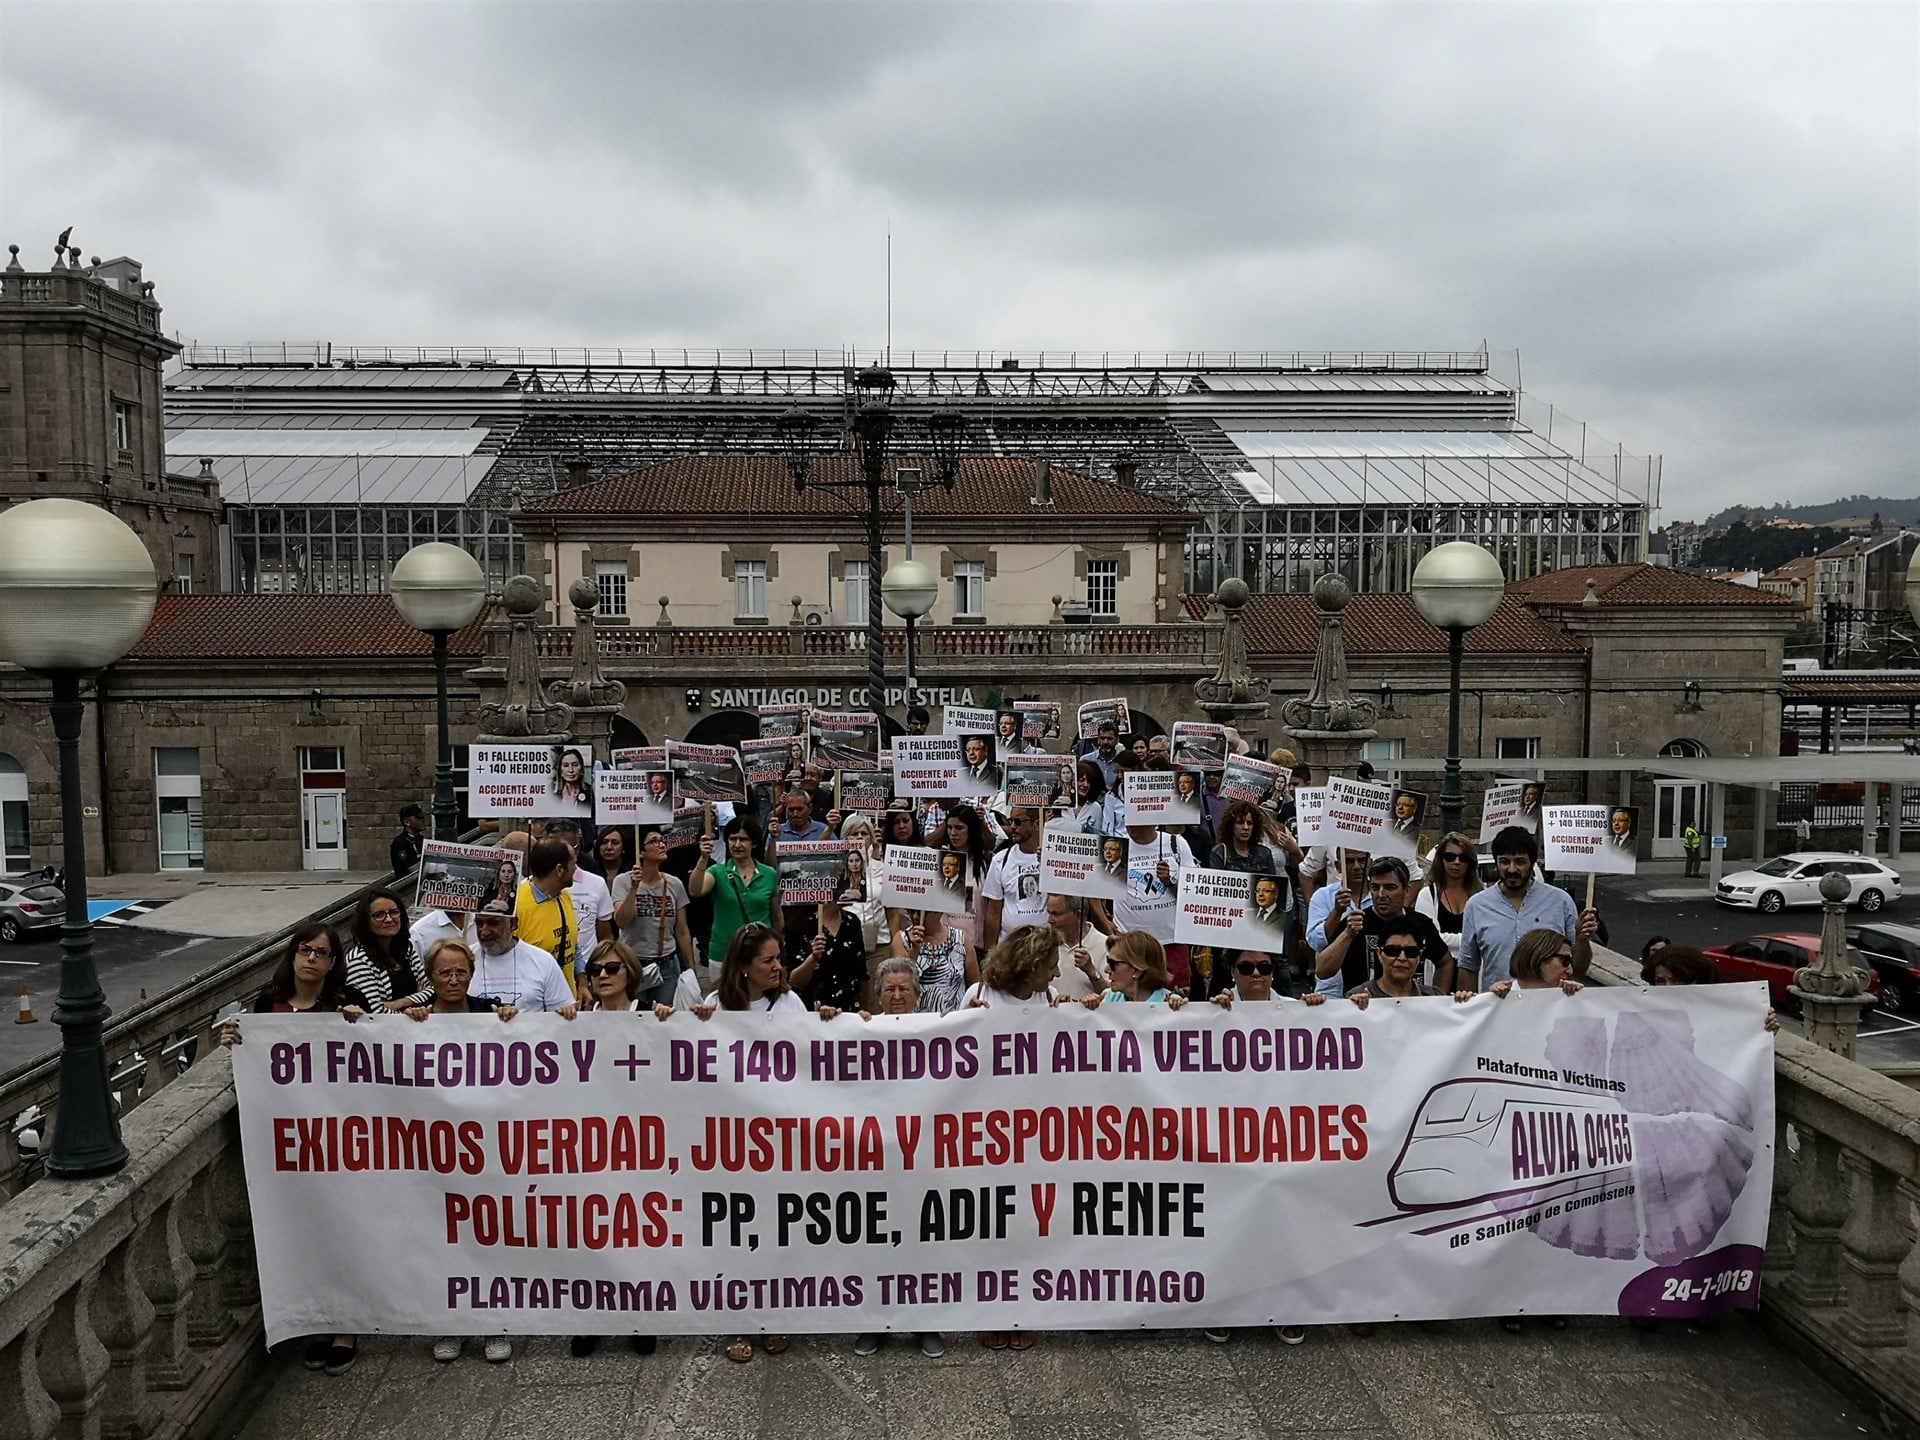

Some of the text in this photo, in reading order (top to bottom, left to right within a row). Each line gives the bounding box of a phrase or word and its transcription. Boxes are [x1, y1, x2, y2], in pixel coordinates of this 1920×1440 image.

[710, 688, 808, 707] SANTIAGO
[816, 688, 842, 707] DE
[849, 716, 870, 724] KNOW
[949, 710, 994, 722] 81 FALLECIDOS
[955, 720, 966, 728] 140
[968, 722, 995, 730] HERIDOS
[678, 745, 712, 756] QUEREMOS
[899, 740, 958, 750] 81 FALLECIDOS
[478, 751, 548, 762] 81 FALLECIDOS
[909, 752, 922, 760] 140
[926, 750, 962, 760] HERIDOS
[476, 764, 552, 774] + 140 HERIDOS
[745, 762, 786, 774] ANA PASTOR
[901, 769, 957, 779] ACCIDENTE AVE
[749, 770, 782, 782] DIMISION
[478, 784, 546, 794] ACCIDENTE AVE
[620, 782, 648, 790] HERIDOS
[911, 780, 948, 789] SANTIAGO
[1008, 784, 1052, 795] ANA PASTOR
[1224, 780, 1264, 796] ANA PASTOR
[842, 787, 889, 798] ANA PASTOR
[1225, 787, 1259, 804] DIMISION
[1302, 792, 1308, 800] 81
[1333, 783, 1390, 801] 81 FALLECIDOS
[490, 798, 534, 807] SANTIAGO
[846, 797, 885, 809] DIMISION
[1012, 794, 1048, 805] DIMISION
[1130, 796, 1160, 804] ACCIDENTE
[1340, 794, 1354, 804] 140
[1356, 798, 1391, 811] HERIDOS
[1137, 804, 1164, 812] SANTIAGO
[1549, 810, 1606, 818] 81 FALLECIDOS
[1328, 810, 1384, 826] ACCIDENTE AVE
[1558, 819, 1572, 828] 140
[1575, 820, 1608, 828] HERIDOS
[1336, 821, 1372, 834] SANTIAGO
[1048, 834, 1098, 847] 81 FALLECIDOS
[1552, 835, 1603, 845] ACCIDENTE AVE
[427, 843, 462, 855] MENTIRAS
[469, 849, 518, 862] OCULTACIONES
[778, 844, 810, 852] MENTIRAS
[818, 842, 863, 852] OCULTACIONES
[1055, 844, 1067, 853] 140
[1068, 846, 1100, 856] HERIDOS
[1561, 845, 1594, 854] SANTIAGO
[890, 850, 937, 862] 81 FALLECIDOS
[897, 860, 908, 868] 140
[910, 861, 940, 872] HERIDOS
[1046, 859, 1080, 870] ACCIDENTE
[1082, 864, 1094, 872] AVE
[888, 874, 934, 886] ACCIDENTE AVE
[1054, 870, 1085, 880] SANTIAGO
[1186, 874, 1248, 888] 81 FALLECIDOS
[422, 879, 486, 897] ANA PASTOR
[780, 877, 838, 890] ANA PASTOR
[896, 884, 926, 894] SANTIAGO
[785, 890, 834, 902] DIMISION
[1183, 886, 1250, 900] + 140 HERIDOS
[425, 893, 478, 910] DIMISION
[1184, 904, 1244, 918] ACCIDENTE AVE
[1193, 916, 1232, 928] SANTIAGO
[270, 1026, 1363, 1088] 81 FALLECIDOS Y + DE 140 HERIDOS EN ALTA VELOCIDAD
[1477, 1055, 1627, 1094] Plataforma Víctimas
[273, 1103, 1369, 1177] EXIGIMOS VERDAD, JUSTICIA Y RESPONSABILIDADES
[1511, 1110, 1633, 1181] ALVIA 04155
[445, 1181, 1206, 1254] POLÍTICAS: PP, PSOE, ADIF Y RENFE
[1449, 1182, 1636, 1249] de Santiago de Compostela
[447, 1268, 1206, 1312] PLATAFORMA VÍCTIMAS TREN DE SANTIAGO
[1660, 1268, 1754, 1303] 24-7-2013
